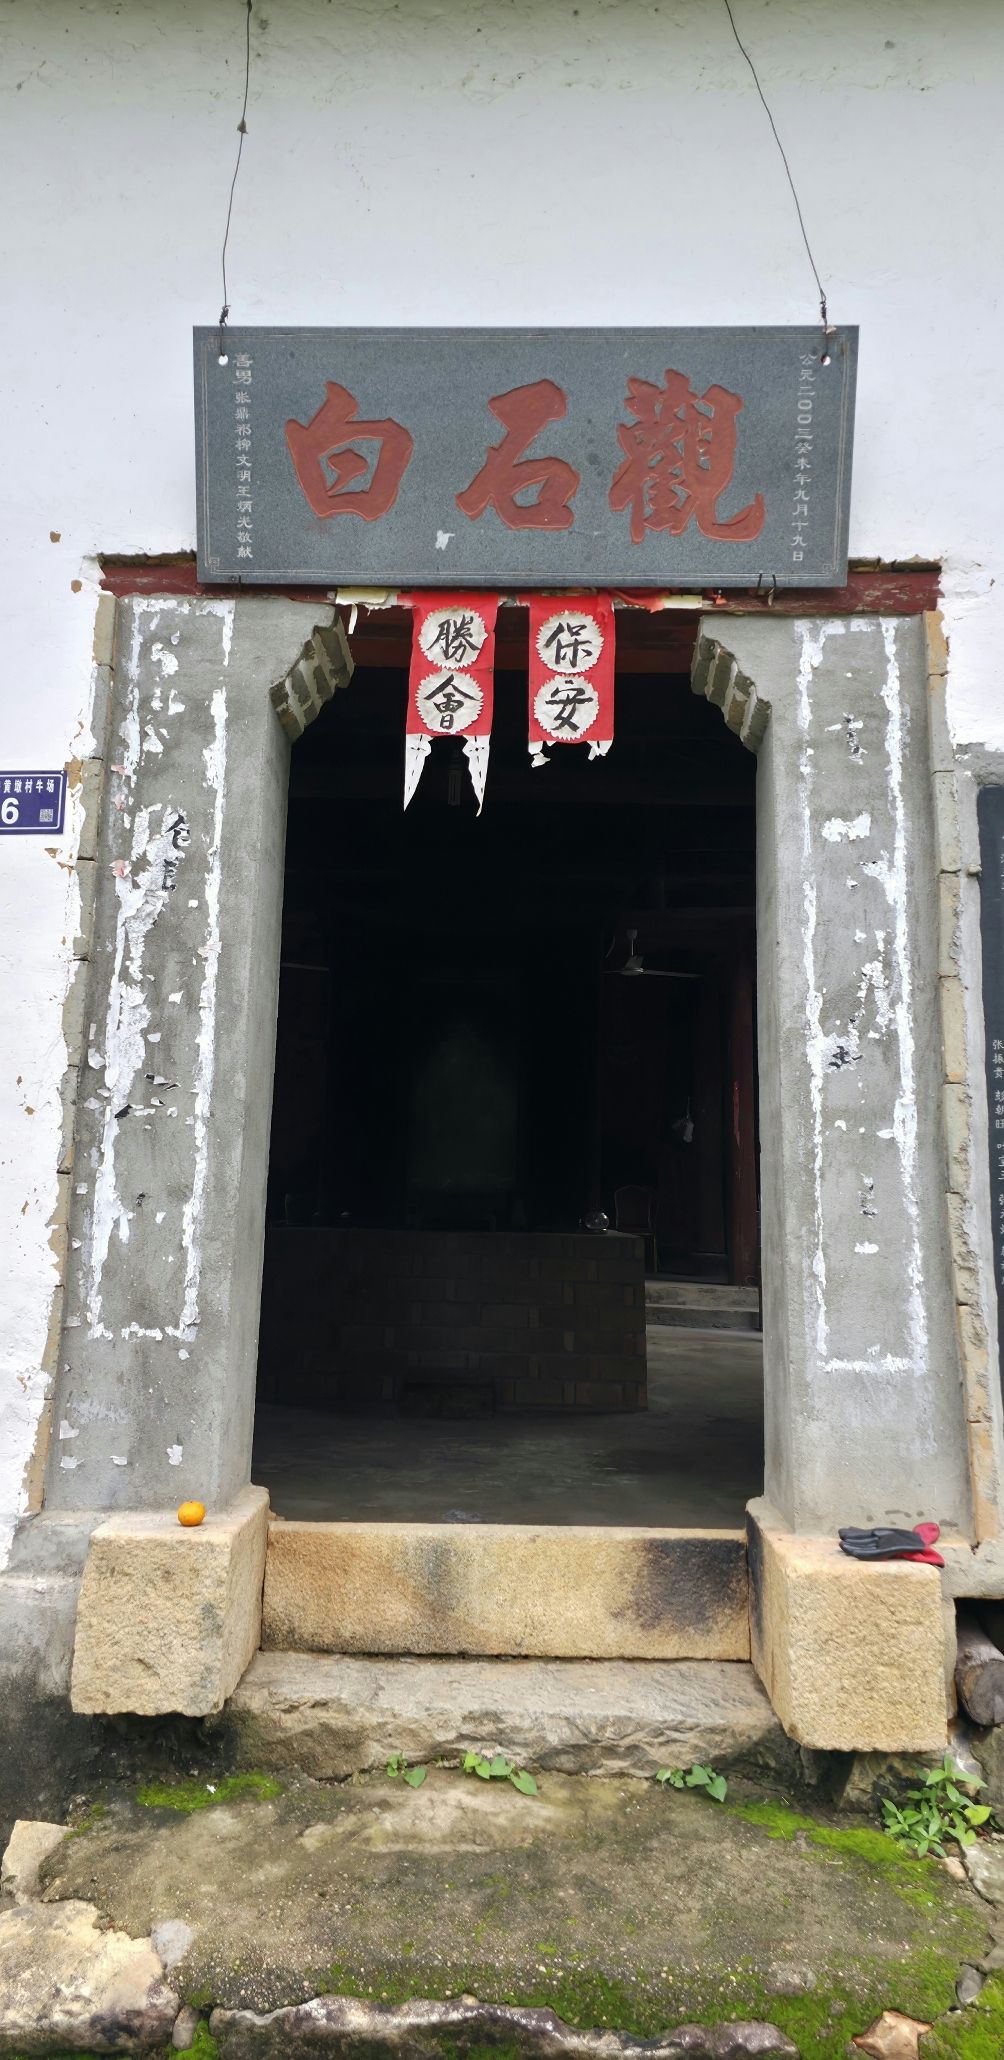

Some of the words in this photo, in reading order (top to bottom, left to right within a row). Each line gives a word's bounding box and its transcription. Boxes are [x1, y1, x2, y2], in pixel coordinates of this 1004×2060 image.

[284, 368, 765, 544] 白石觀
[1, 797, 19, 825] 6
